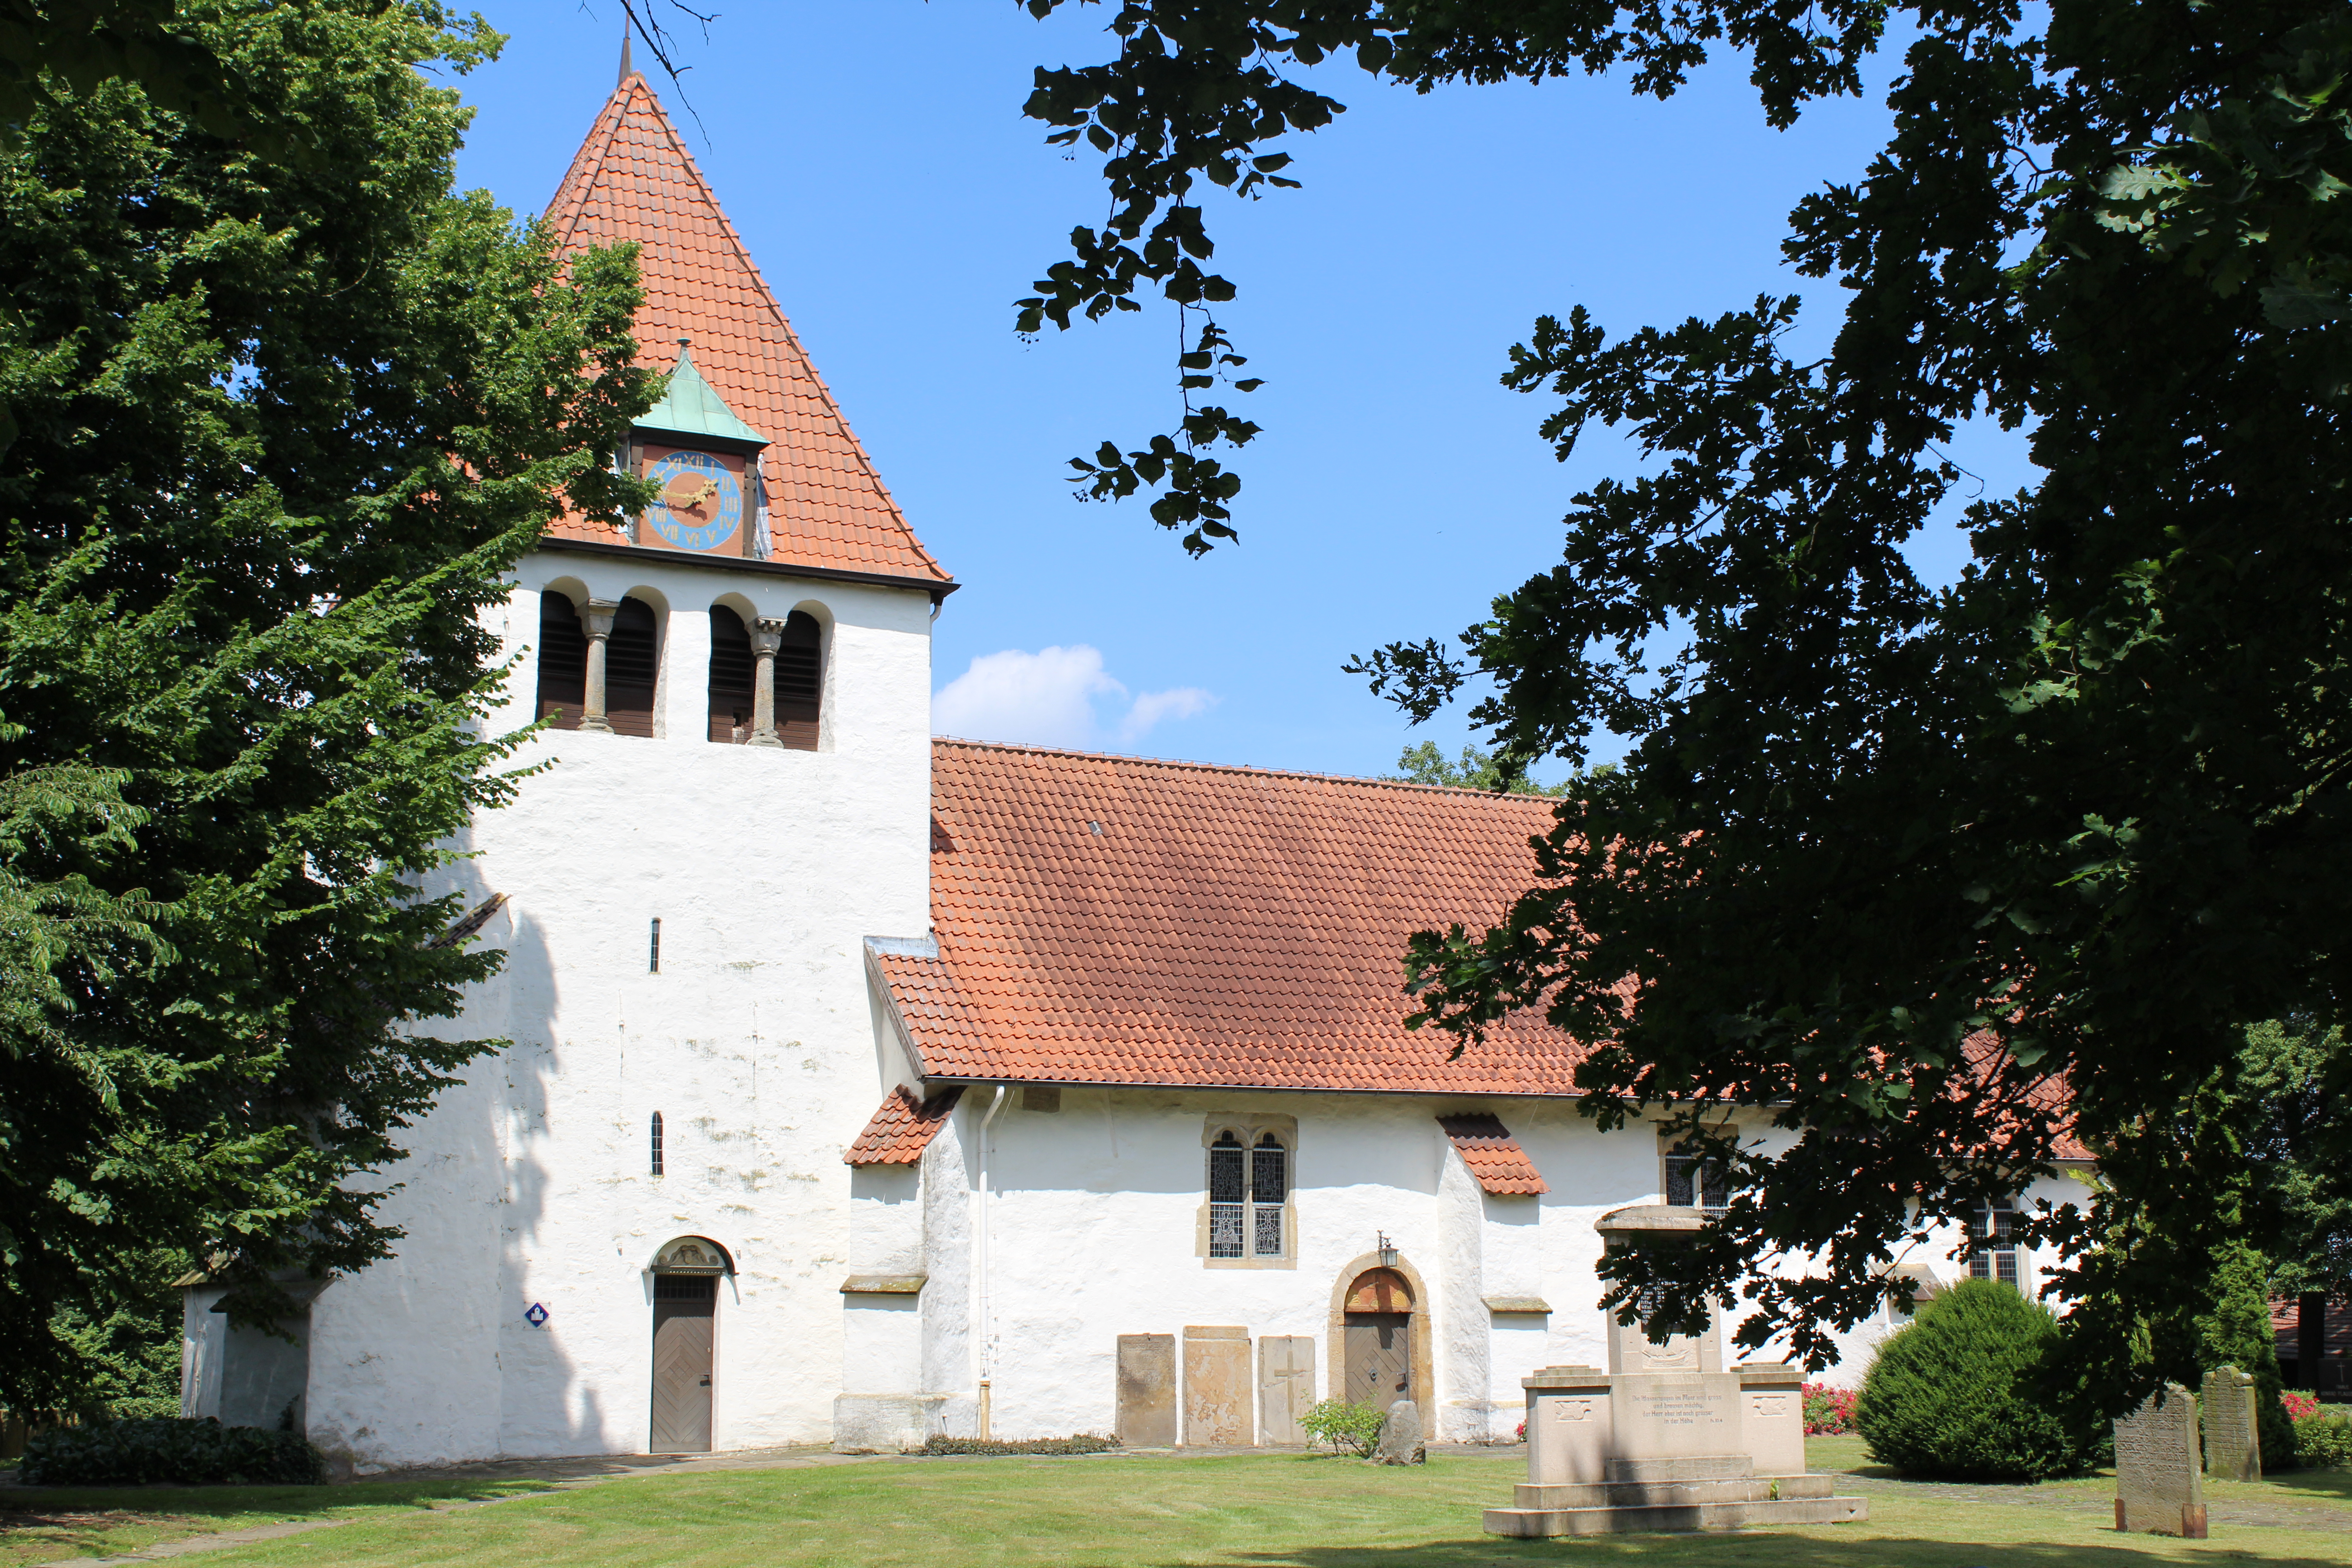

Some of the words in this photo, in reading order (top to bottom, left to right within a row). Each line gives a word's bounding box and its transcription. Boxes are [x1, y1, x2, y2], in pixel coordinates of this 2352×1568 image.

[666, 457, 682, 472] XI
[684, 454, 704, 470] XII
[711, 461, 715, 476] I
[721, 477, 730, 491] II
[725, 497, 738, 512] III
[720, 515, 735, 530] IV
[661, 524, 679, 540] VII
[685, 531, 699, 547] VI
[706, 529, 717, 544] V
